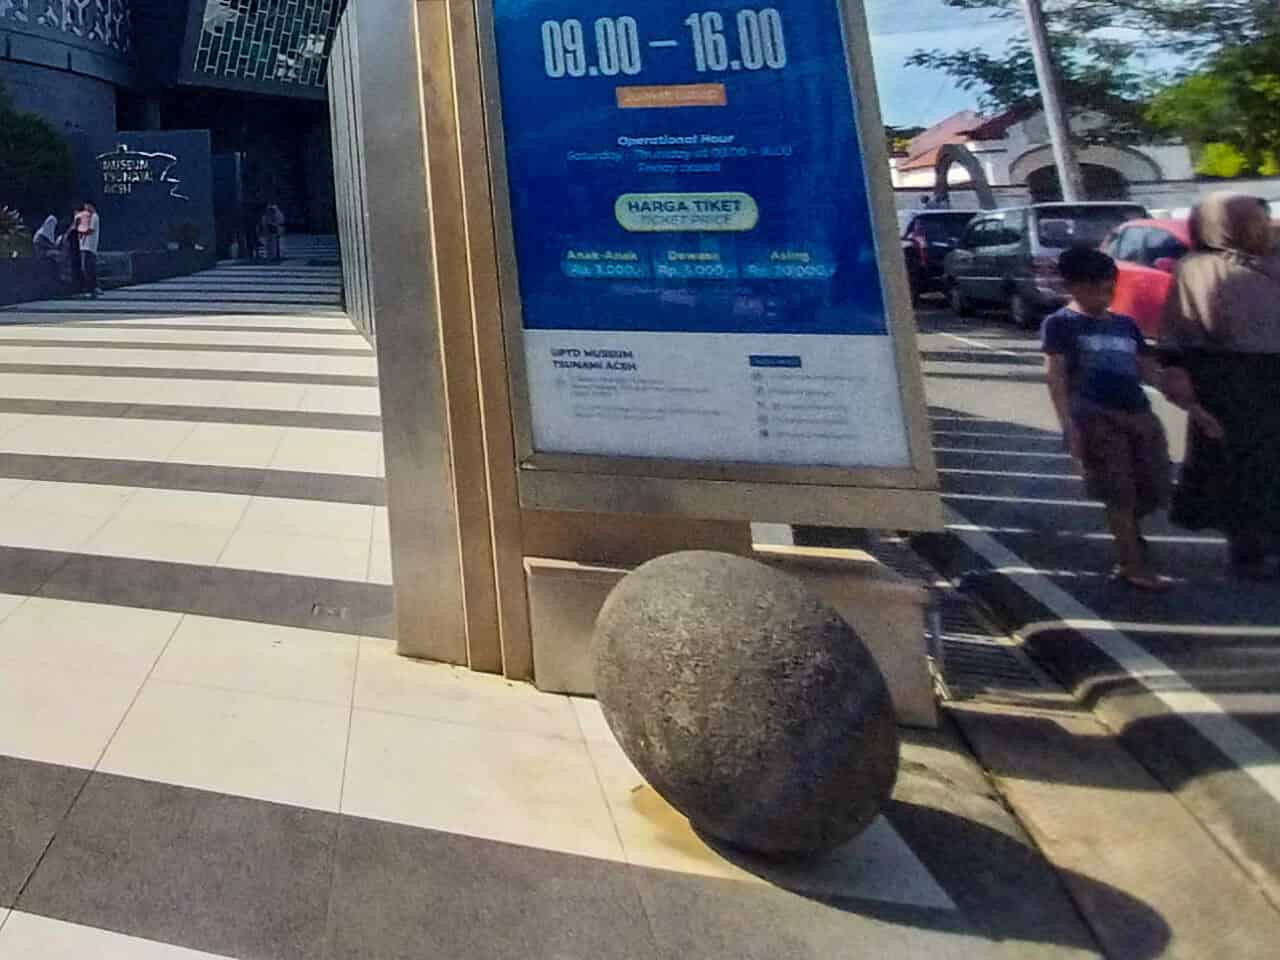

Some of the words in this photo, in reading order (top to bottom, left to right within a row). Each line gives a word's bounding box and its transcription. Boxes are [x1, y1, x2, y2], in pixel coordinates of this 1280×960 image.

[541, 15, 642, 78] 09.00
[684, 7, 788, 73] 16.00
[617, 134, 698, 147] Operational
[701, 133, 736, 144] Hour
[102, 160, 150, 171] MUSEUM
[628, 200, 689, 213] HARGA
[692, 199, 742, 212] TIKET
[566, 249, 638, 261] Anak-Anak
